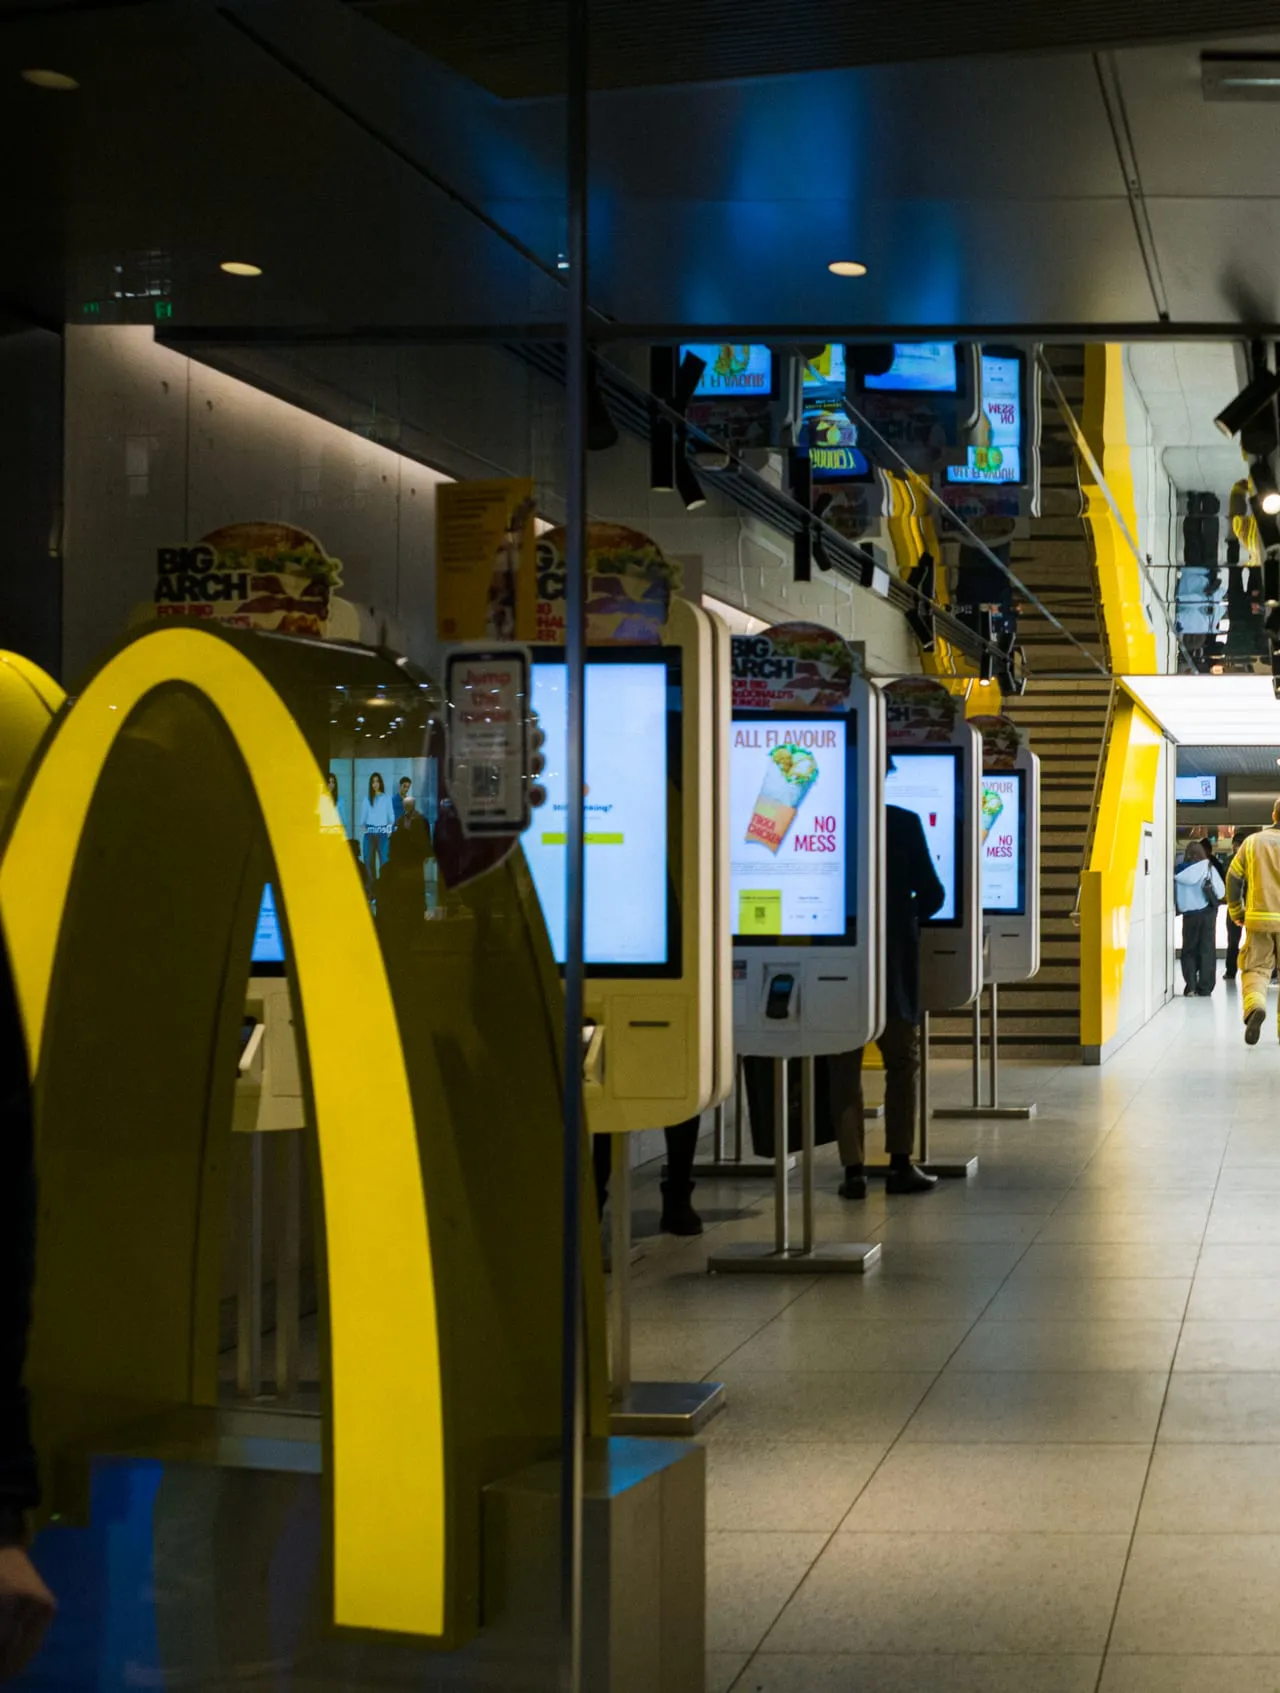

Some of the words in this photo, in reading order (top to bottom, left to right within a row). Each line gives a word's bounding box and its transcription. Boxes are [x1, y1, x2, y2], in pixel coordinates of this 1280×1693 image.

[157, 547, 214, 574] BIG
[155, 573, 248, 602] ARCH
[460, 669, 512, 686] Jump
[732, 679, 747, 689] OR
[734, 730, 761, 748] ALL
[765, 730, 837, 748] FLAVOUR
[813, 815, 837, 834] NO
[793, 834, 837, 853] MESS
[998, 834, 1014, 847] NO
[986, 846, 1014, 859] MESS
